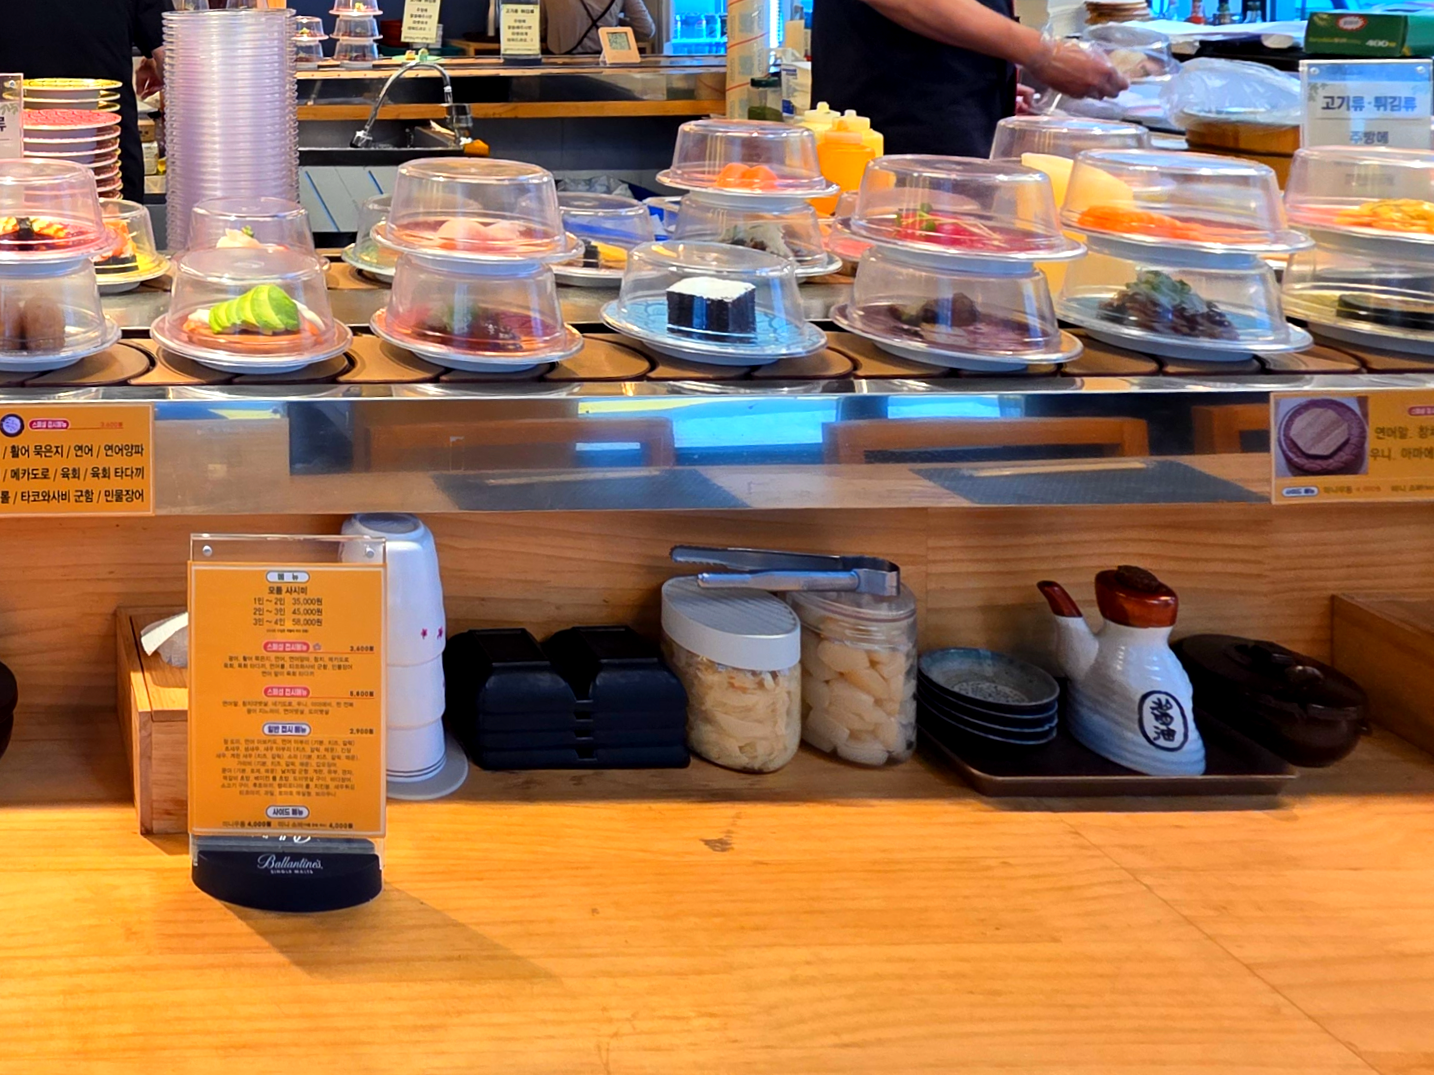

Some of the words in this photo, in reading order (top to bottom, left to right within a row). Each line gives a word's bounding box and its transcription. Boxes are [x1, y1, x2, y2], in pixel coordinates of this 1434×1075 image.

[1349, 130, 1389, 145] 주방에
[10, 445, 30, 458] 활어
[33, 444, 64, 458] 묵은지
[73, 444, 93, 457] 연어
[103, 443, 144, 457] 연어양파
[10, 467, 51, 481] 메카도로
[60, 467, 81, 480] 육회
[90, 467, 111, 480] 육회
[114, 466, 145, 480] 타다끼
[20, 490, 71, 503] 타코와사비
[73, 490, 94, 503] 군함
[104, 489, 144, 503] 민물장어
[285, 586, 308, 595] 사시미
[292, 597, 323, 606] 35,000원
[292, 608, 323, 616] 45,000원
[292, 618, 323, 626] 58,000원
